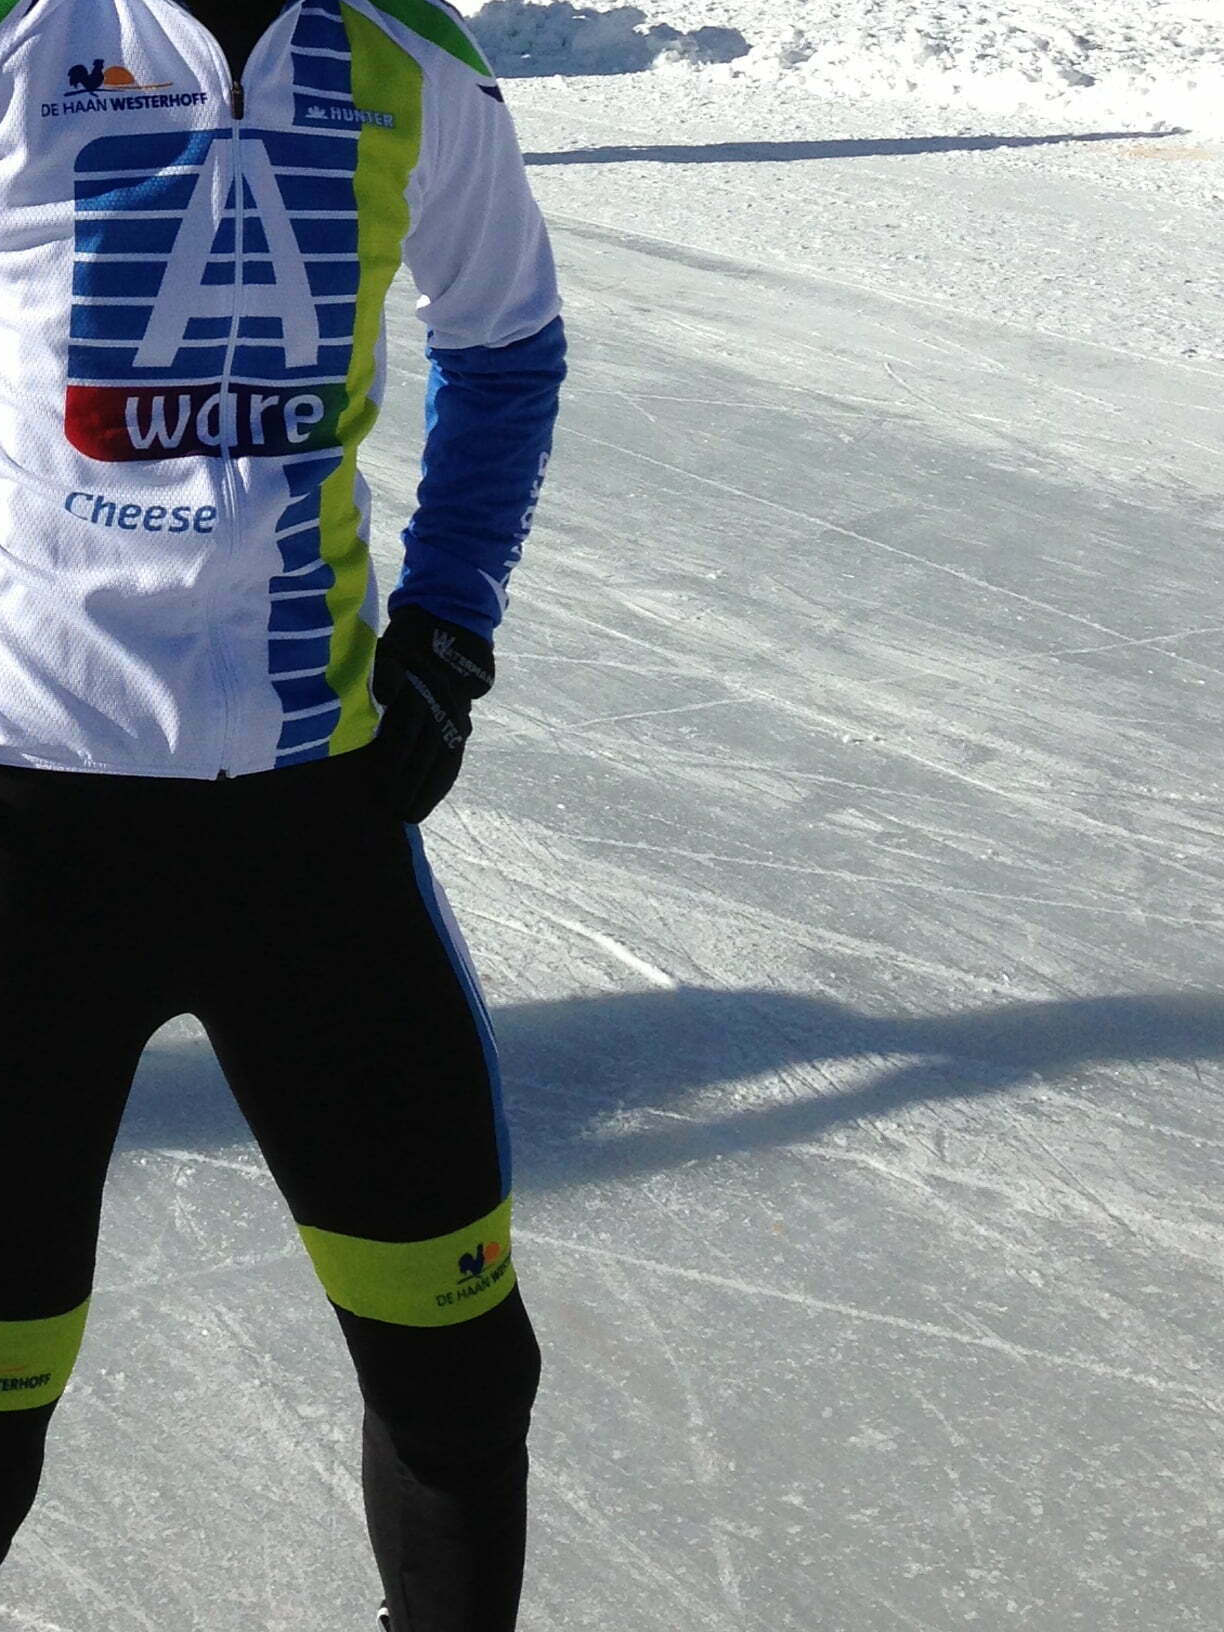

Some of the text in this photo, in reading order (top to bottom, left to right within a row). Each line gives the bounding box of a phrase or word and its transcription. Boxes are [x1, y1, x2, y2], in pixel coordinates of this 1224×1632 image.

[41, 92, 208, 117] DE HAAN WESTERHOFF
[330, 106, 393, 127] HUNTER
[124, 390, 325, 451] ware
[64, 490, 217, 535] Cheese
[436, 1292, 453, 1307] DE
